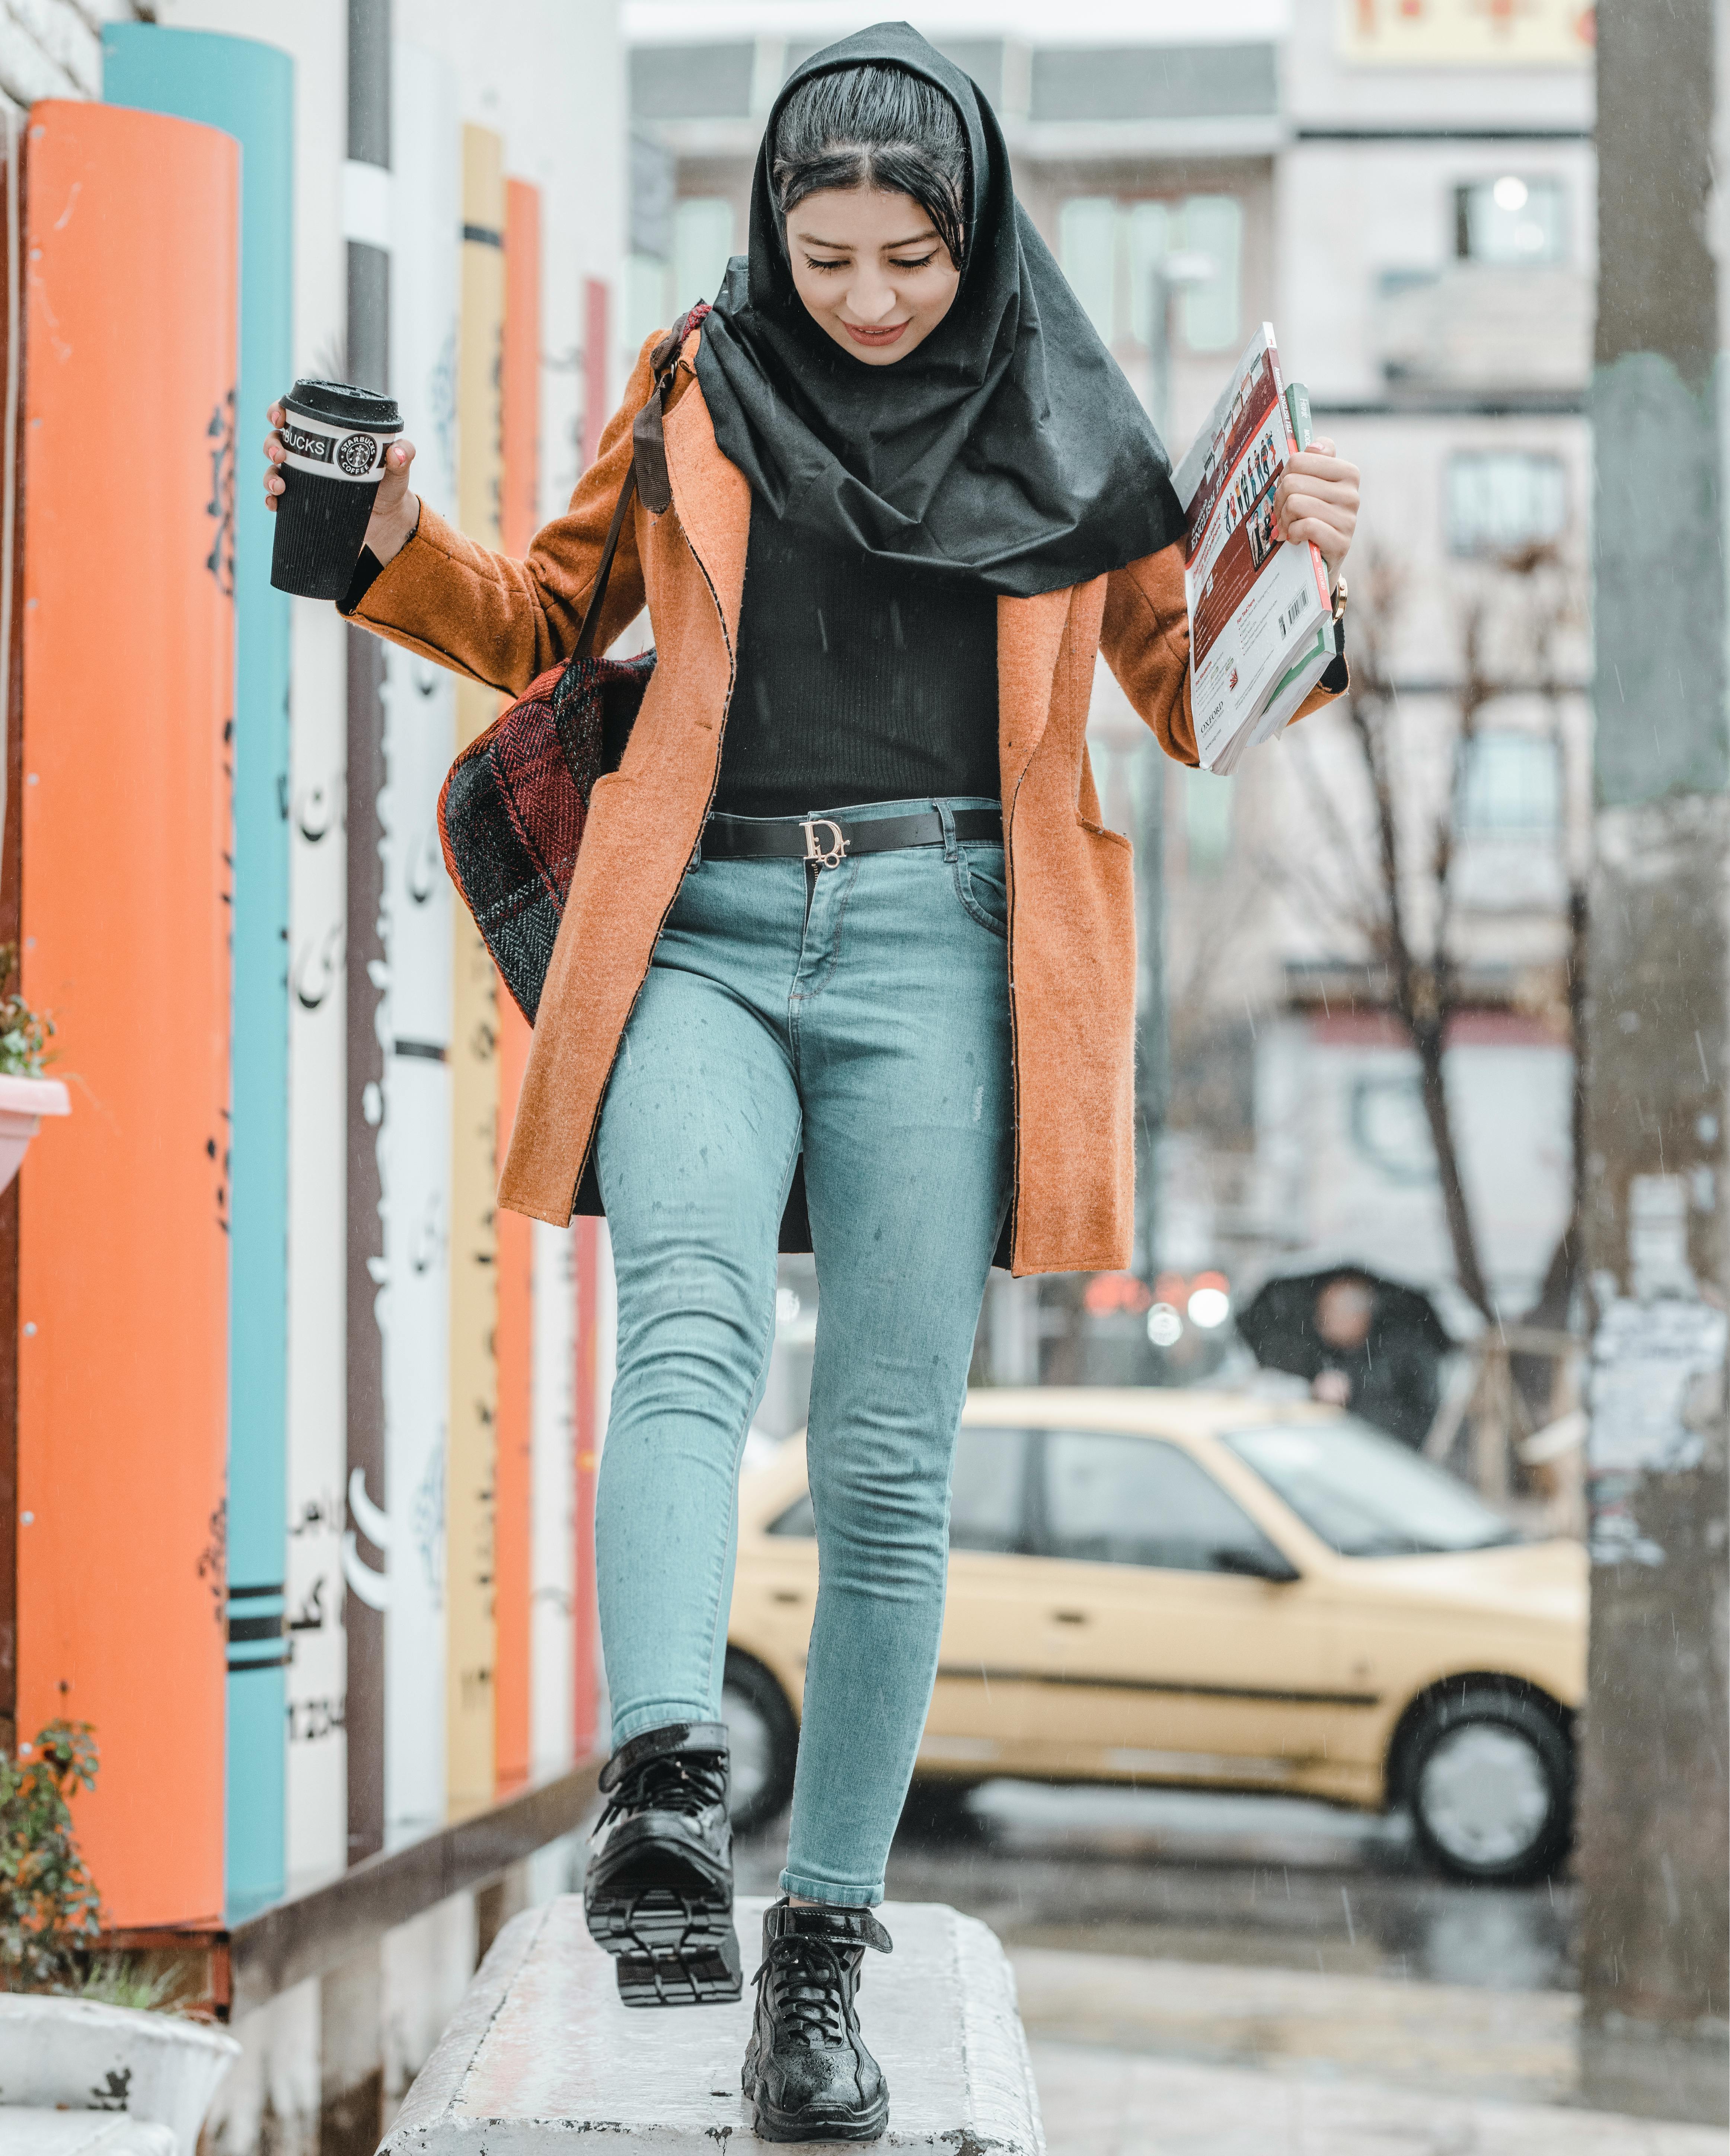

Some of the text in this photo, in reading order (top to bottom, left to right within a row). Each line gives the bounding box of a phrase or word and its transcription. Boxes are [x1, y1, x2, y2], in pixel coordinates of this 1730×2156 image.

[1274, 367, 1283, 394] American
[1280, 395, 1290, 420] ENGLISH
[1299, 398, 1310, 419] Frank
[341, 436, 376, 455] STARBUCKS
[1241, 427, 1252, 447] EDITION
[342, 462, 369, 475] COFFEE
[1191, 489, 1215, 552] ENGLISH
[1216, 459, 1228, 495] FILE
[1191, 498, 1207, 536] American
[1318, 567, 1326, 590] OXFORD
[1242, 598, 1255, 617] Teachers
[1260, 612, 1268, 625] Software
[1268, 599, 1277, 612] DVD-ROM
[1255, 622, 1267, 639] Management
[1200, 661, 1212, 680] Students
[1201, 701, 1223, 733] OXFORD
[1203, 720, 1217, 738] UNIVERSITY
[1205, 729, 1221, 750] www.oup.com
